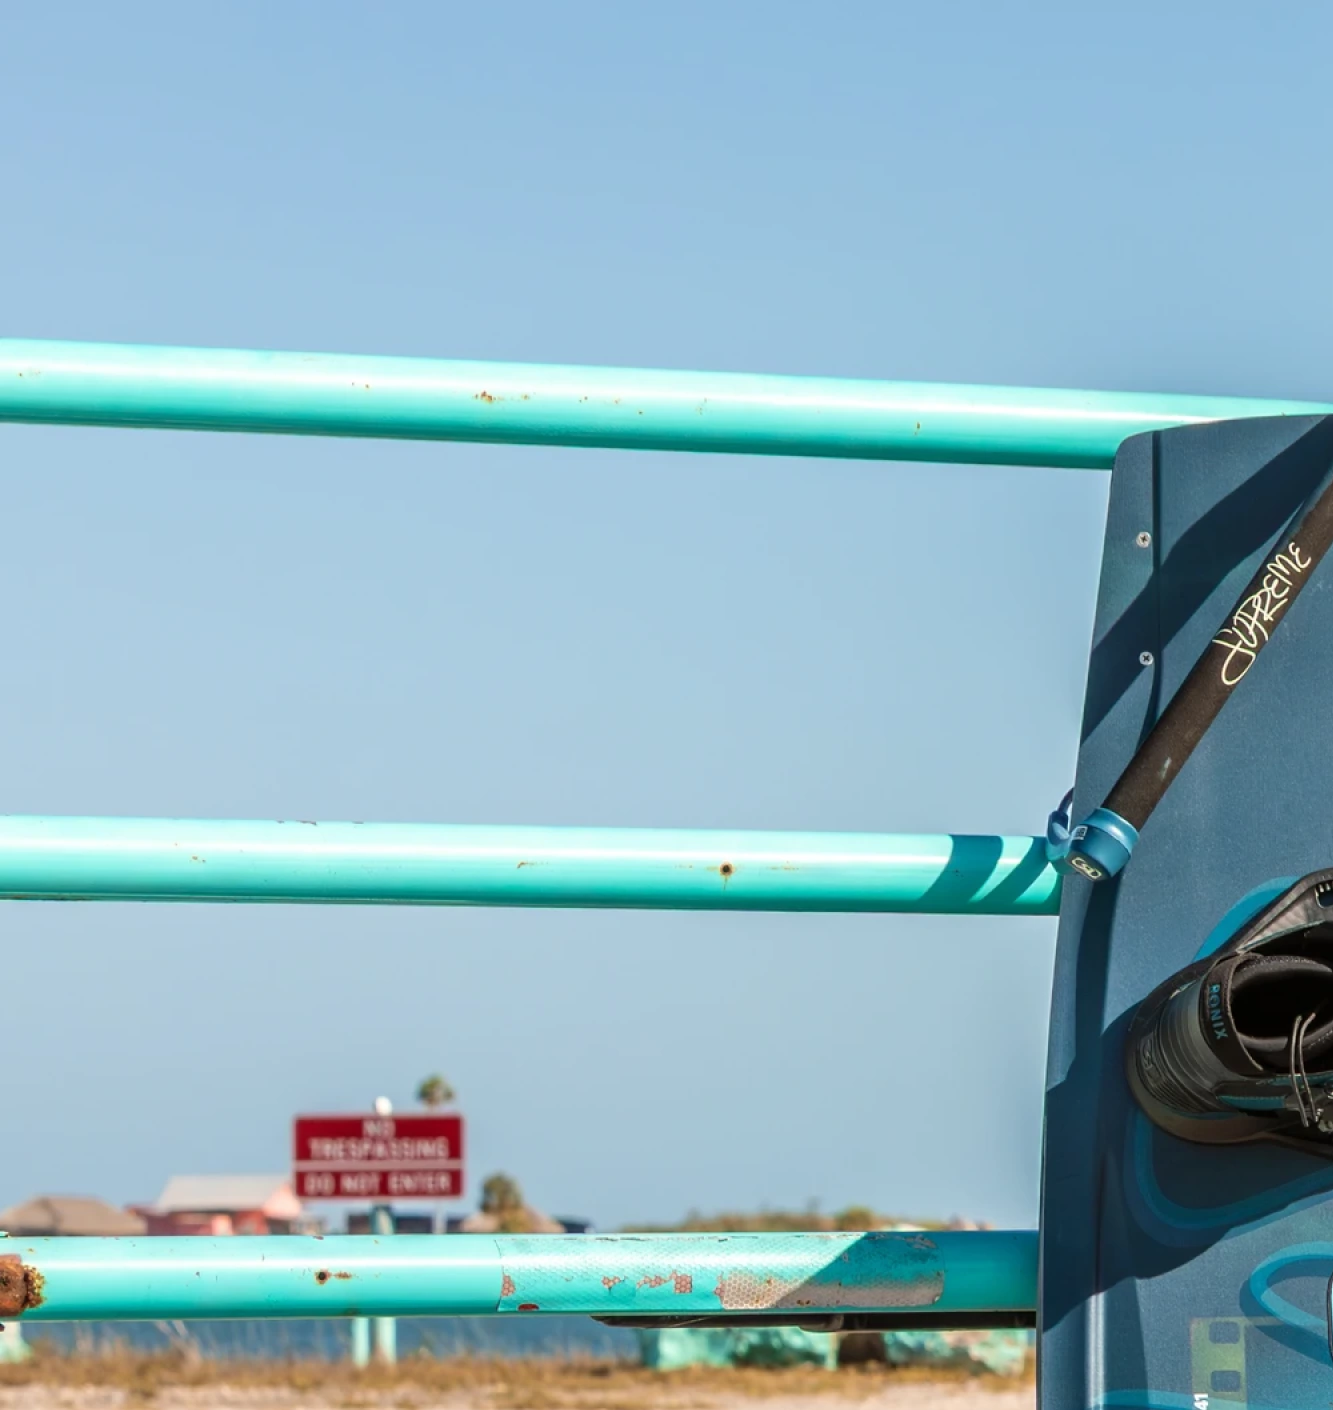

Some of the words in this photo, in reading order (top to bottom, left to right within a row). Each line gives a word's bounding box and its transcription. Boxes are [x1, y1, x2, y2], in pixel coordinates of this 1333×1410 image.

[1209, 984, 1229, 1040] RONIX
[362, 1119, 397, 1137] NO
[309, 1137, 450, 1160] TRESPASSING
[304, 1172, 336, 1196] DO
[340, 1172, 380, 1195] NOT
[387, 1172, 452, 1195] ENTER
